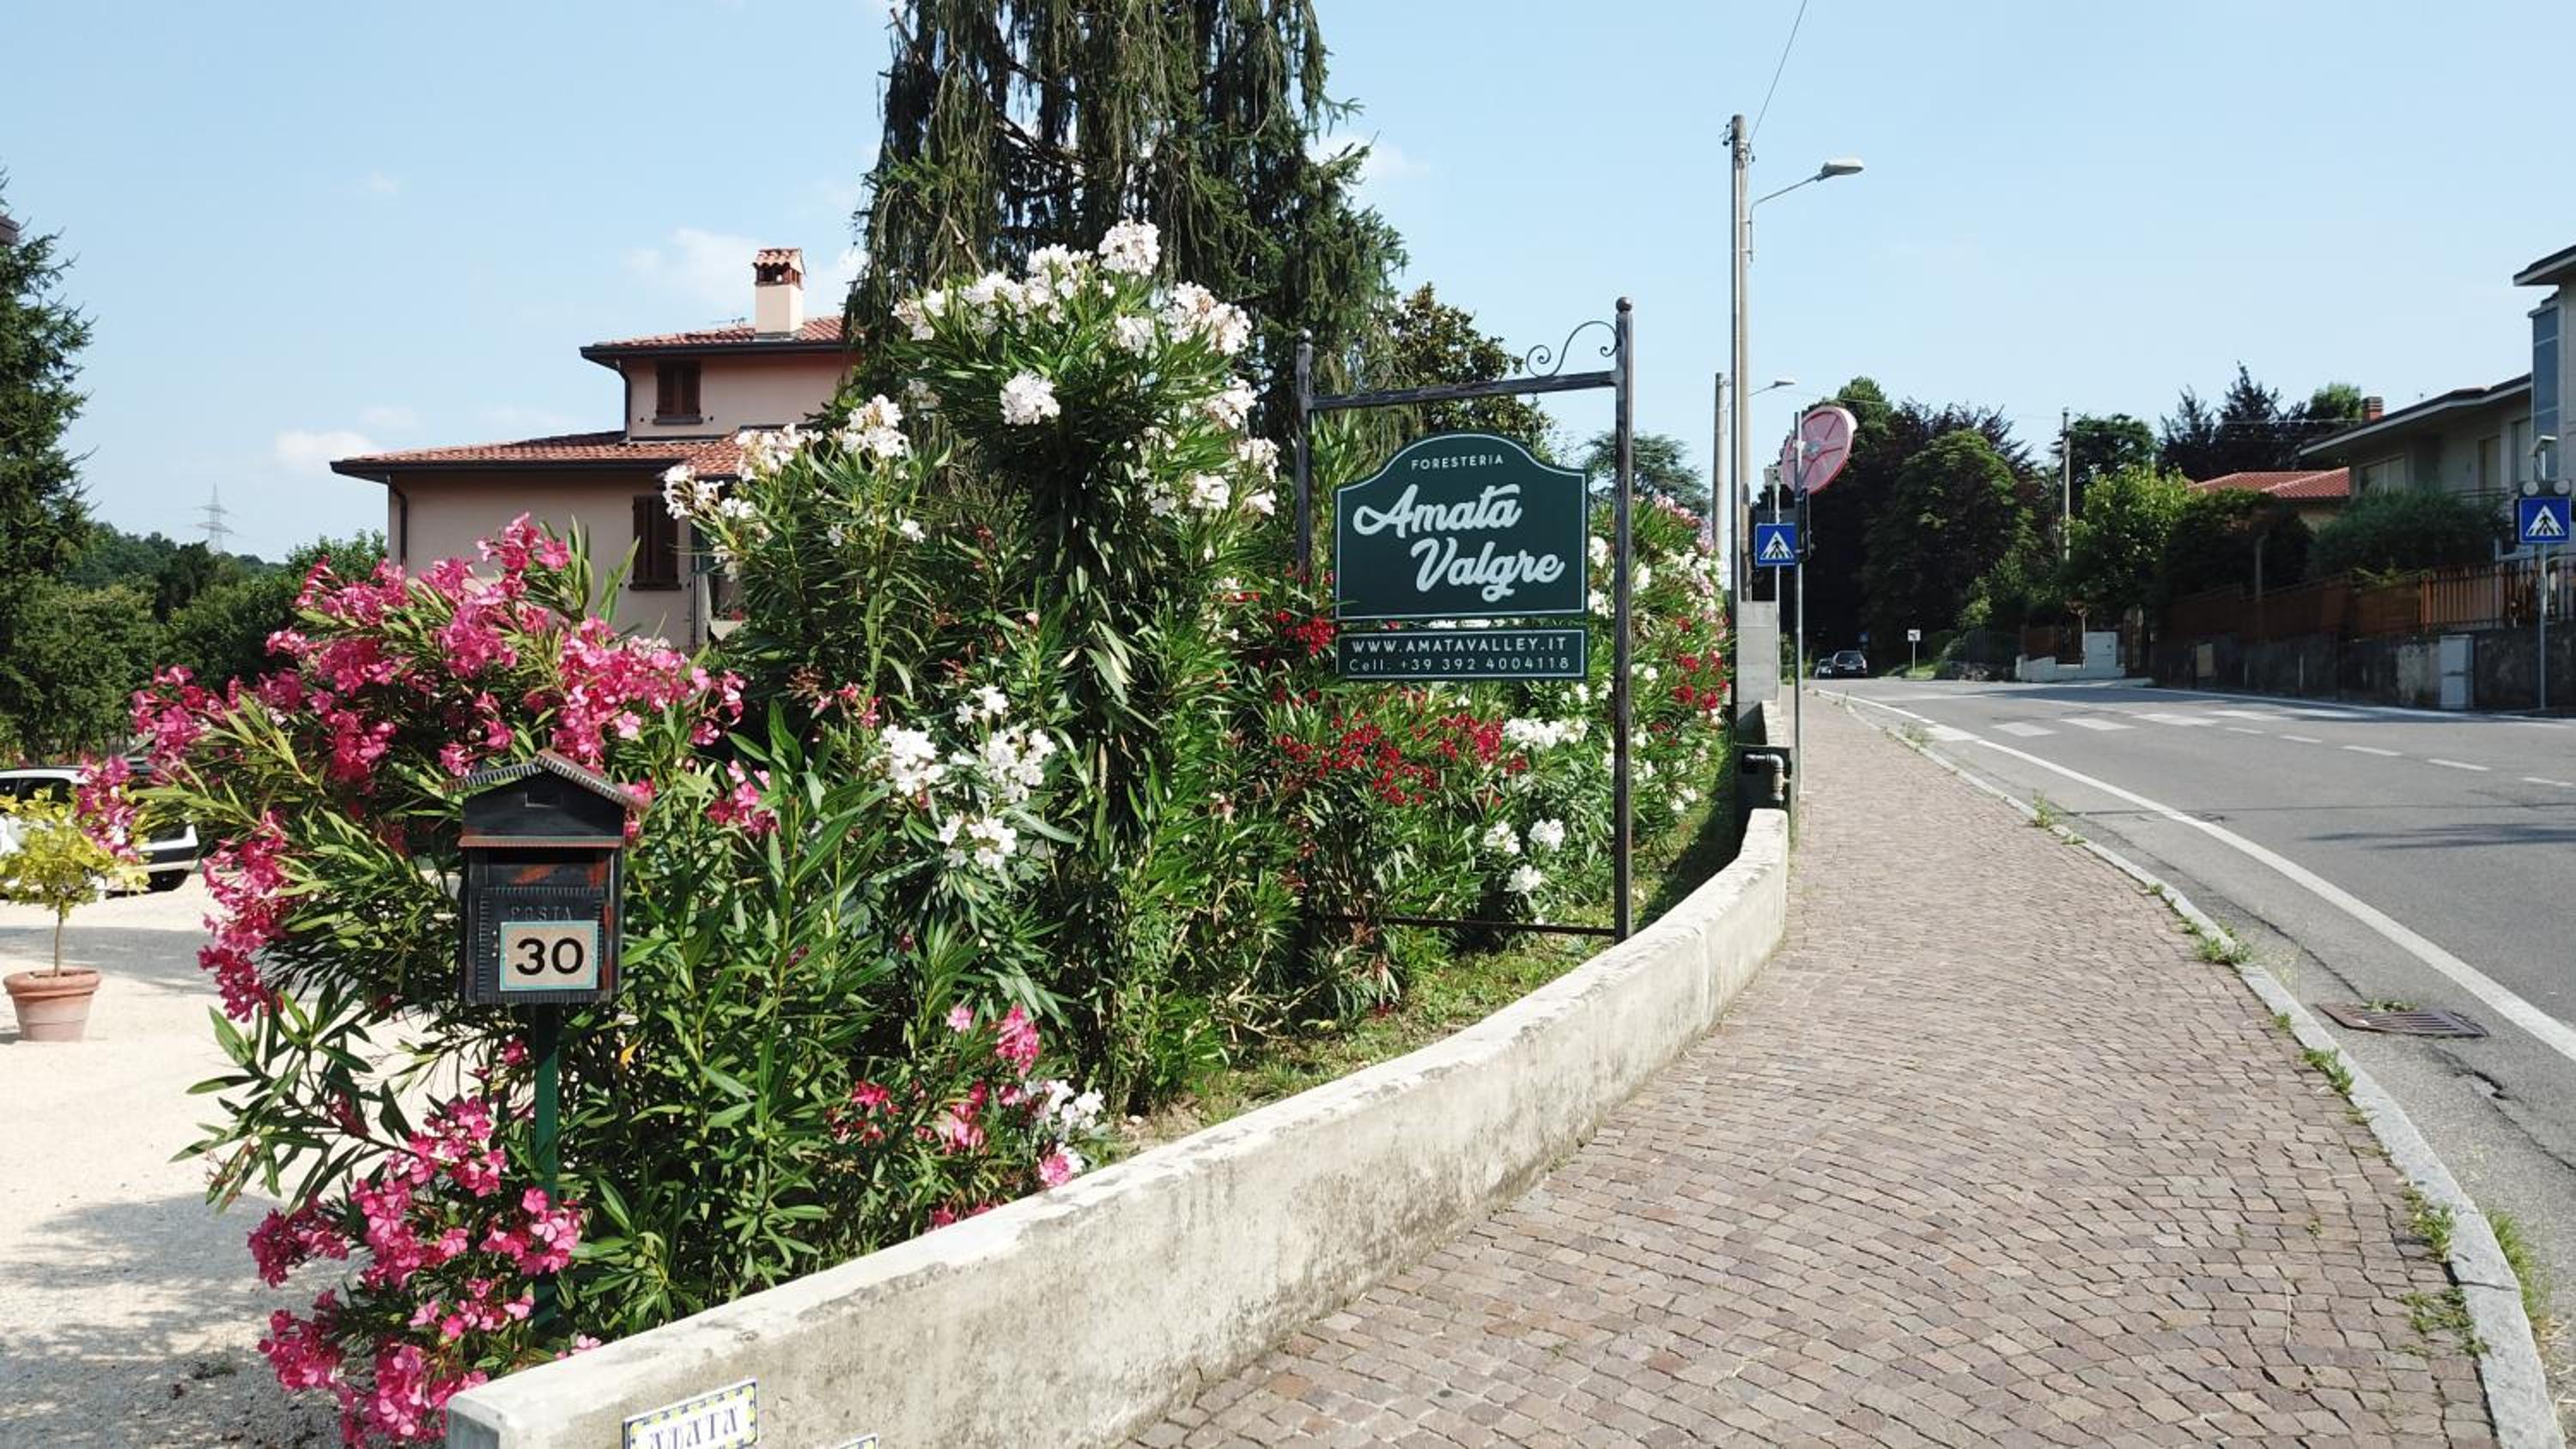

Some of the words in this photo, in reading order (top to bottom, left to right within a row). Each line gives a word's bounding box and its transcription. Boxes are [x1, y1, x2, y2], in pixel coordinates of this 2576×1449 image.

[1411, 454, 1504, 470] FORESTERIA
[1352, 483, 1522, 538] Amata
[1410, 537, 1565, 602] Valgre
[1352, 637, 1567, 653] WWW.AMATAVALLEY.IT
[1400, 658, 1432, 671] +39
[1442, 658, 1476, 670] 392
[1485, 657, 1570, 670] 4004118
[511, 906, 572, 921] POSTA
[515, 937, 585, 976] 30
